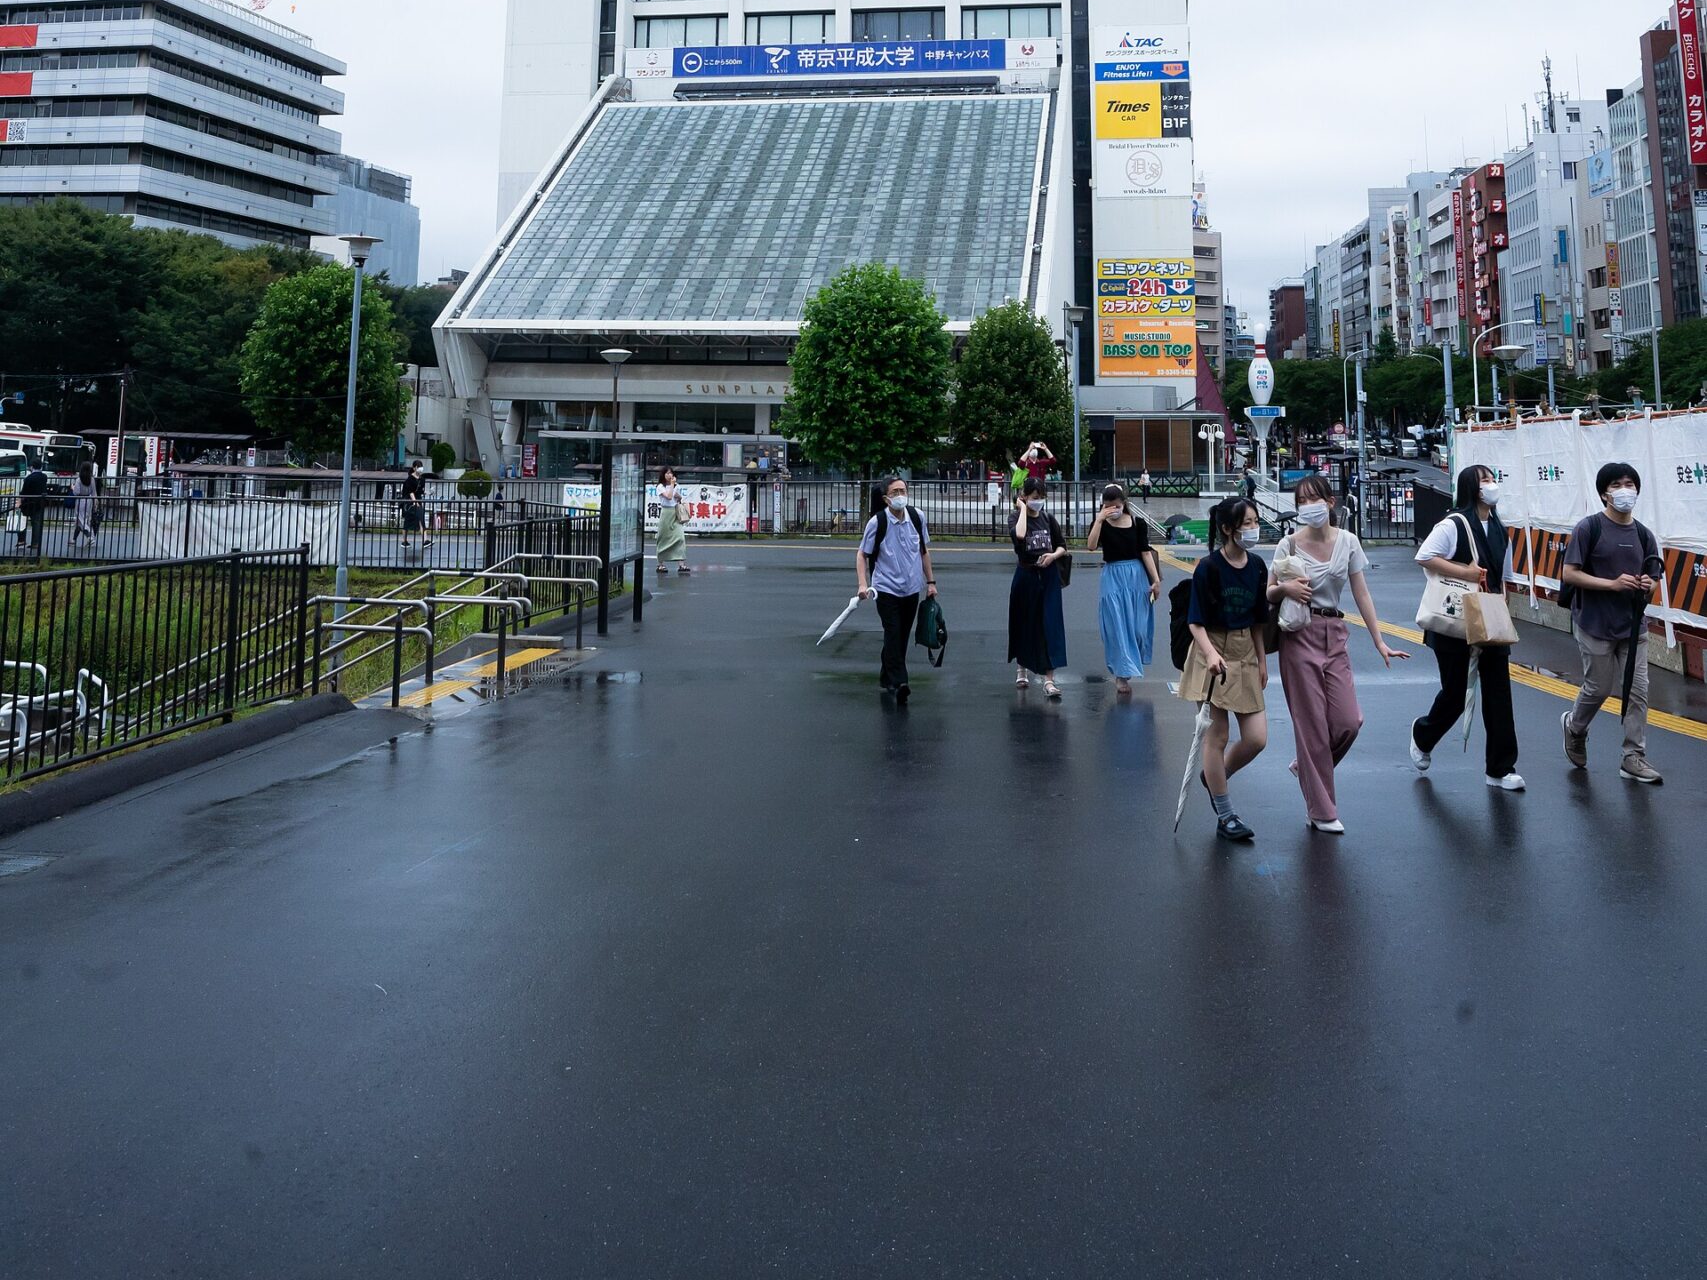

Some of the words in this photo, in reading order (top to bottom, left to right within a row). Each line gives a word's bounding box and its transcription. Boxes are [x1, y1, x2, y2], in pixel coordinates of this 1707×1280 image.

[1133, 37, 1164, 48] TAC
[703, 58, 743, 67] ここから500m
[797, 46, 915, 69] 帝京平成大学
[924, 49, 990, 61] 中野キャンパス
[1115, 63, 1141, 71] ENJOY
[1103, 70, 1130, 78] Fitness
[1106, 100, 1151, 113] Times
[1163, 117, 1188, 129] B1F
[1688, 94, 1707, 153] カラオケ
[1102, 261, 1191, 276] コミック・ネット
[1127, 278, 1167, 297] 24h
[1174, 280, 1186, 289] B1
[1102, 299, 1192, 313] カラオケ・ダーツ
[1124, 333, 1146, 341] MUSIC
[1146, 333, 1171, 341] STUDIO
[1103, 344, 1136, 356] BASS
[1163, 344, 1192, 356] TOP
[109, 438, 118, 465] KIRIN
[1352, 475, 1359, 485] 7
